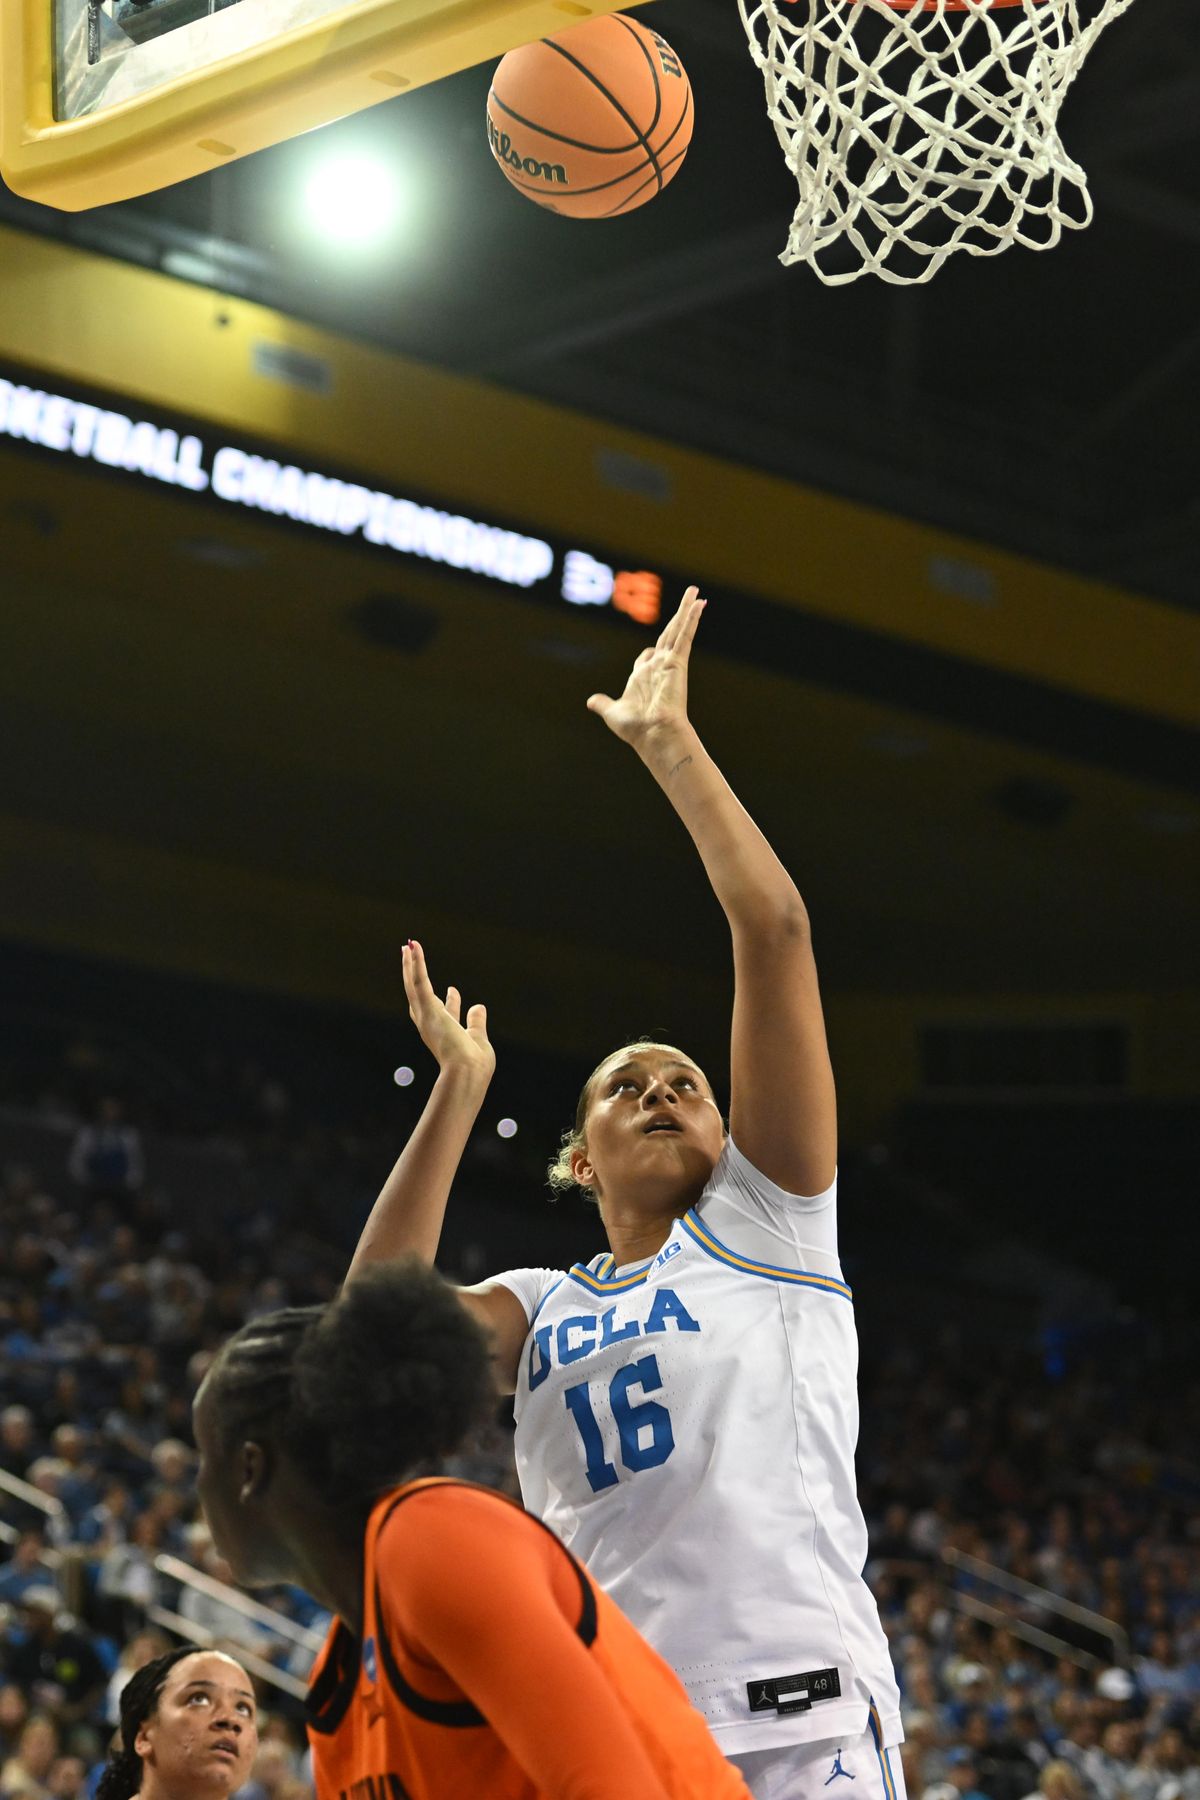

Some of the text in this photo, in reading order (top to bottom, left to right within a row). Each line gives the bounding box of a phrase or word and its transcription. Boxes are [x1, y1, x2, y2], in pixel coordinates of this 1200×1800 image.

[211, 446, 554, 588] CHAMPIONSHIP
[529, 1289, 701, 1392] UCLA
[565, 1353, 675, 1493] 16
[814, 1678, 828, 1691] 48
